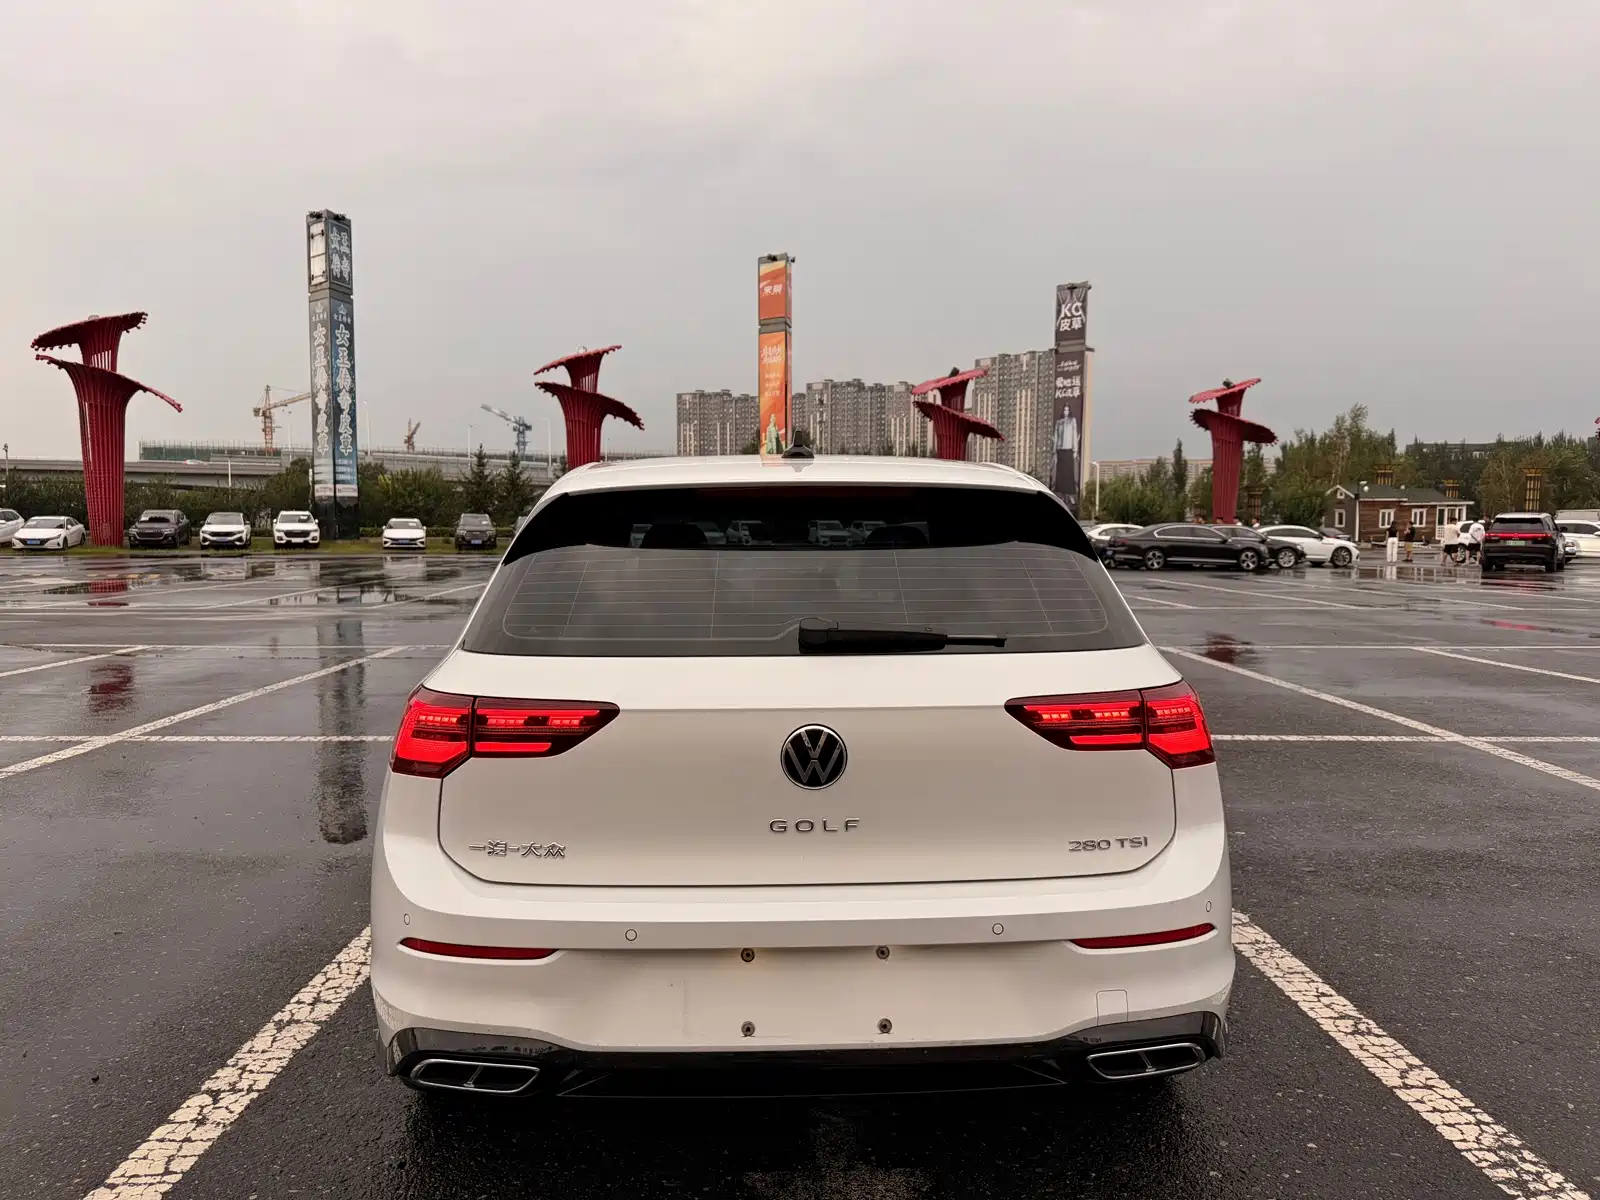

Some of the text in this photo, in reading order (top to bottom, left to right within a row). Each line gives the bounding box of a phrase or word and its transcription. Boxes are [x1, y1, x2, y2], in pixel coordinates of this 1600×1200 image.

[1061, 302, 1082, 318] KC
[335, 323, 353, 456] 女王传奇皮草
[769, 818, 860, 832] GOLF
[1068, 836, 1148, 852] 280 TSI
